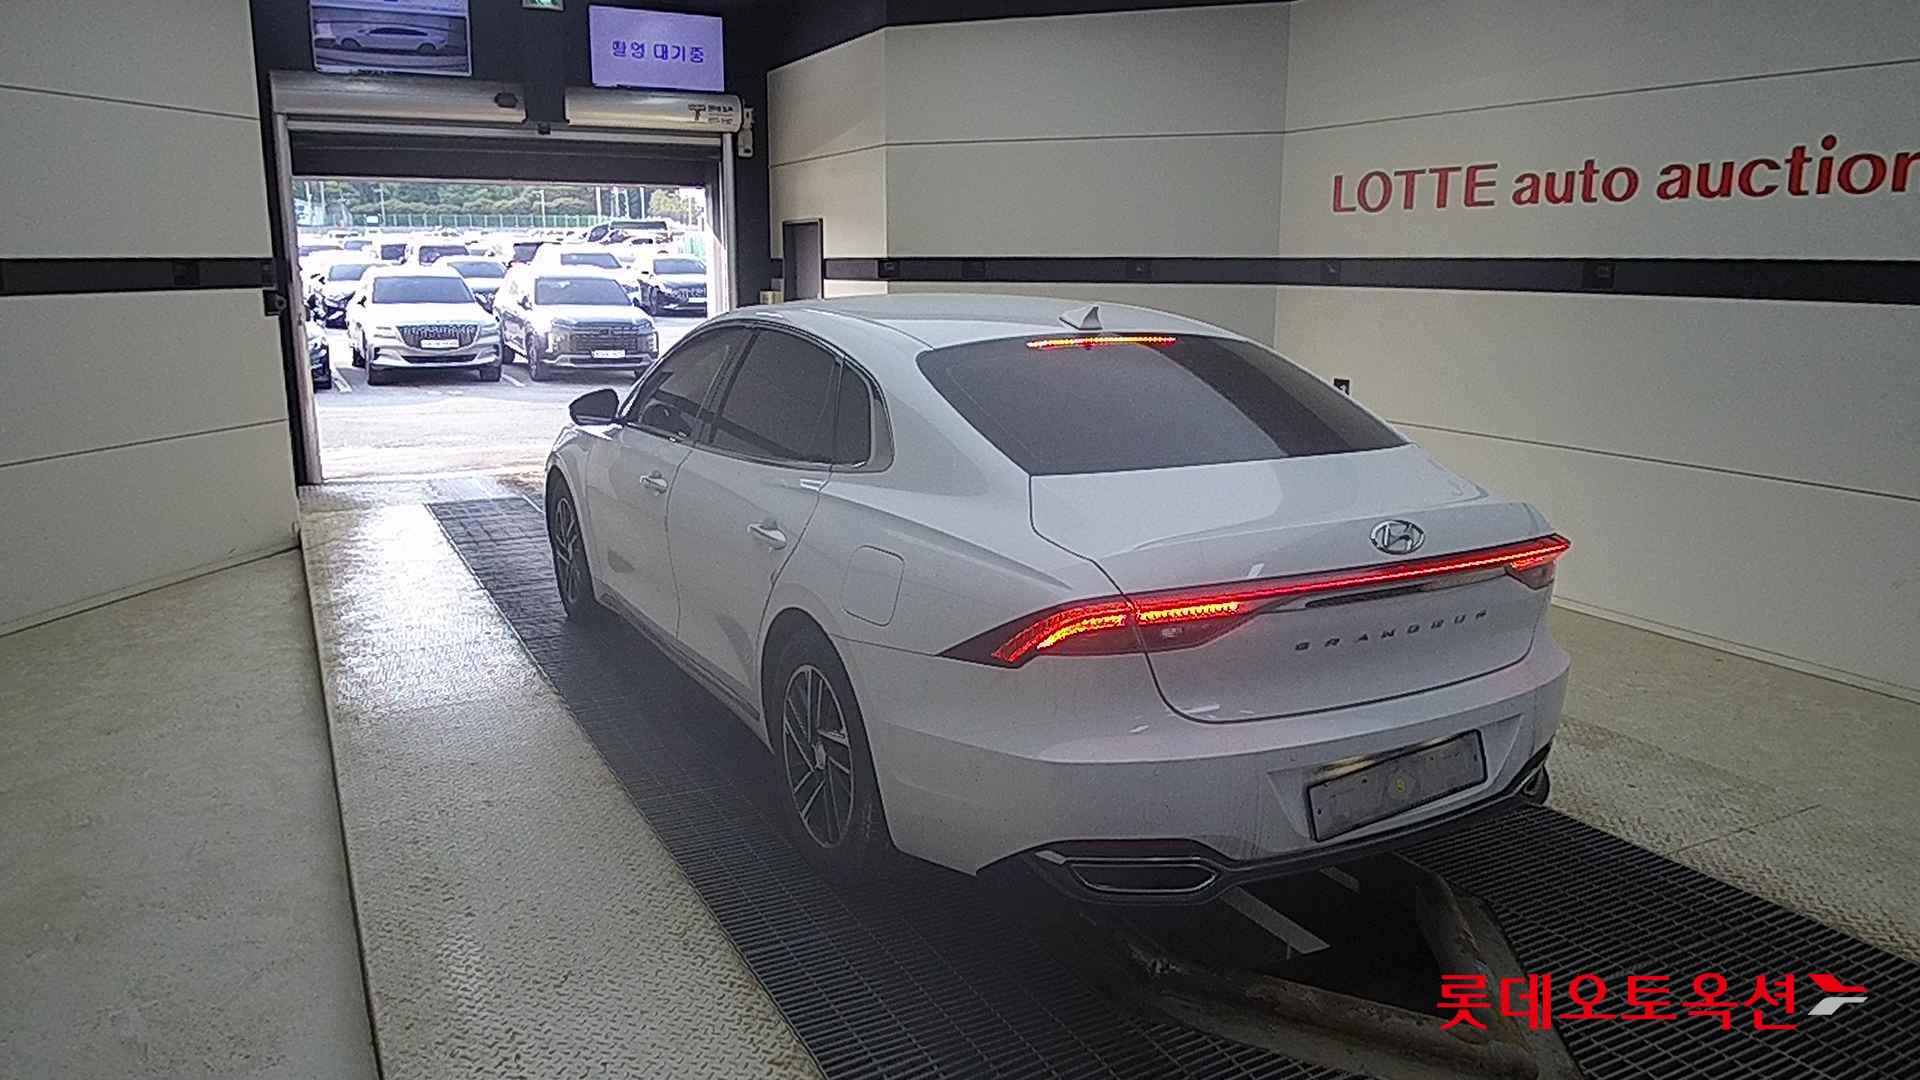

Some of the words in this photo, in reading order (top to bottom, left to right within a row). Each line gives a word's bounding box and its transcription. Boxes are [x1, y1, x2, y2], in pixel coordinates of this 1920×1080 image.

[653, 43, 704, 63] 대기중
[1333, 163, 1498, 213] LOTTE
[1512, 159, 1639, 205] auto
